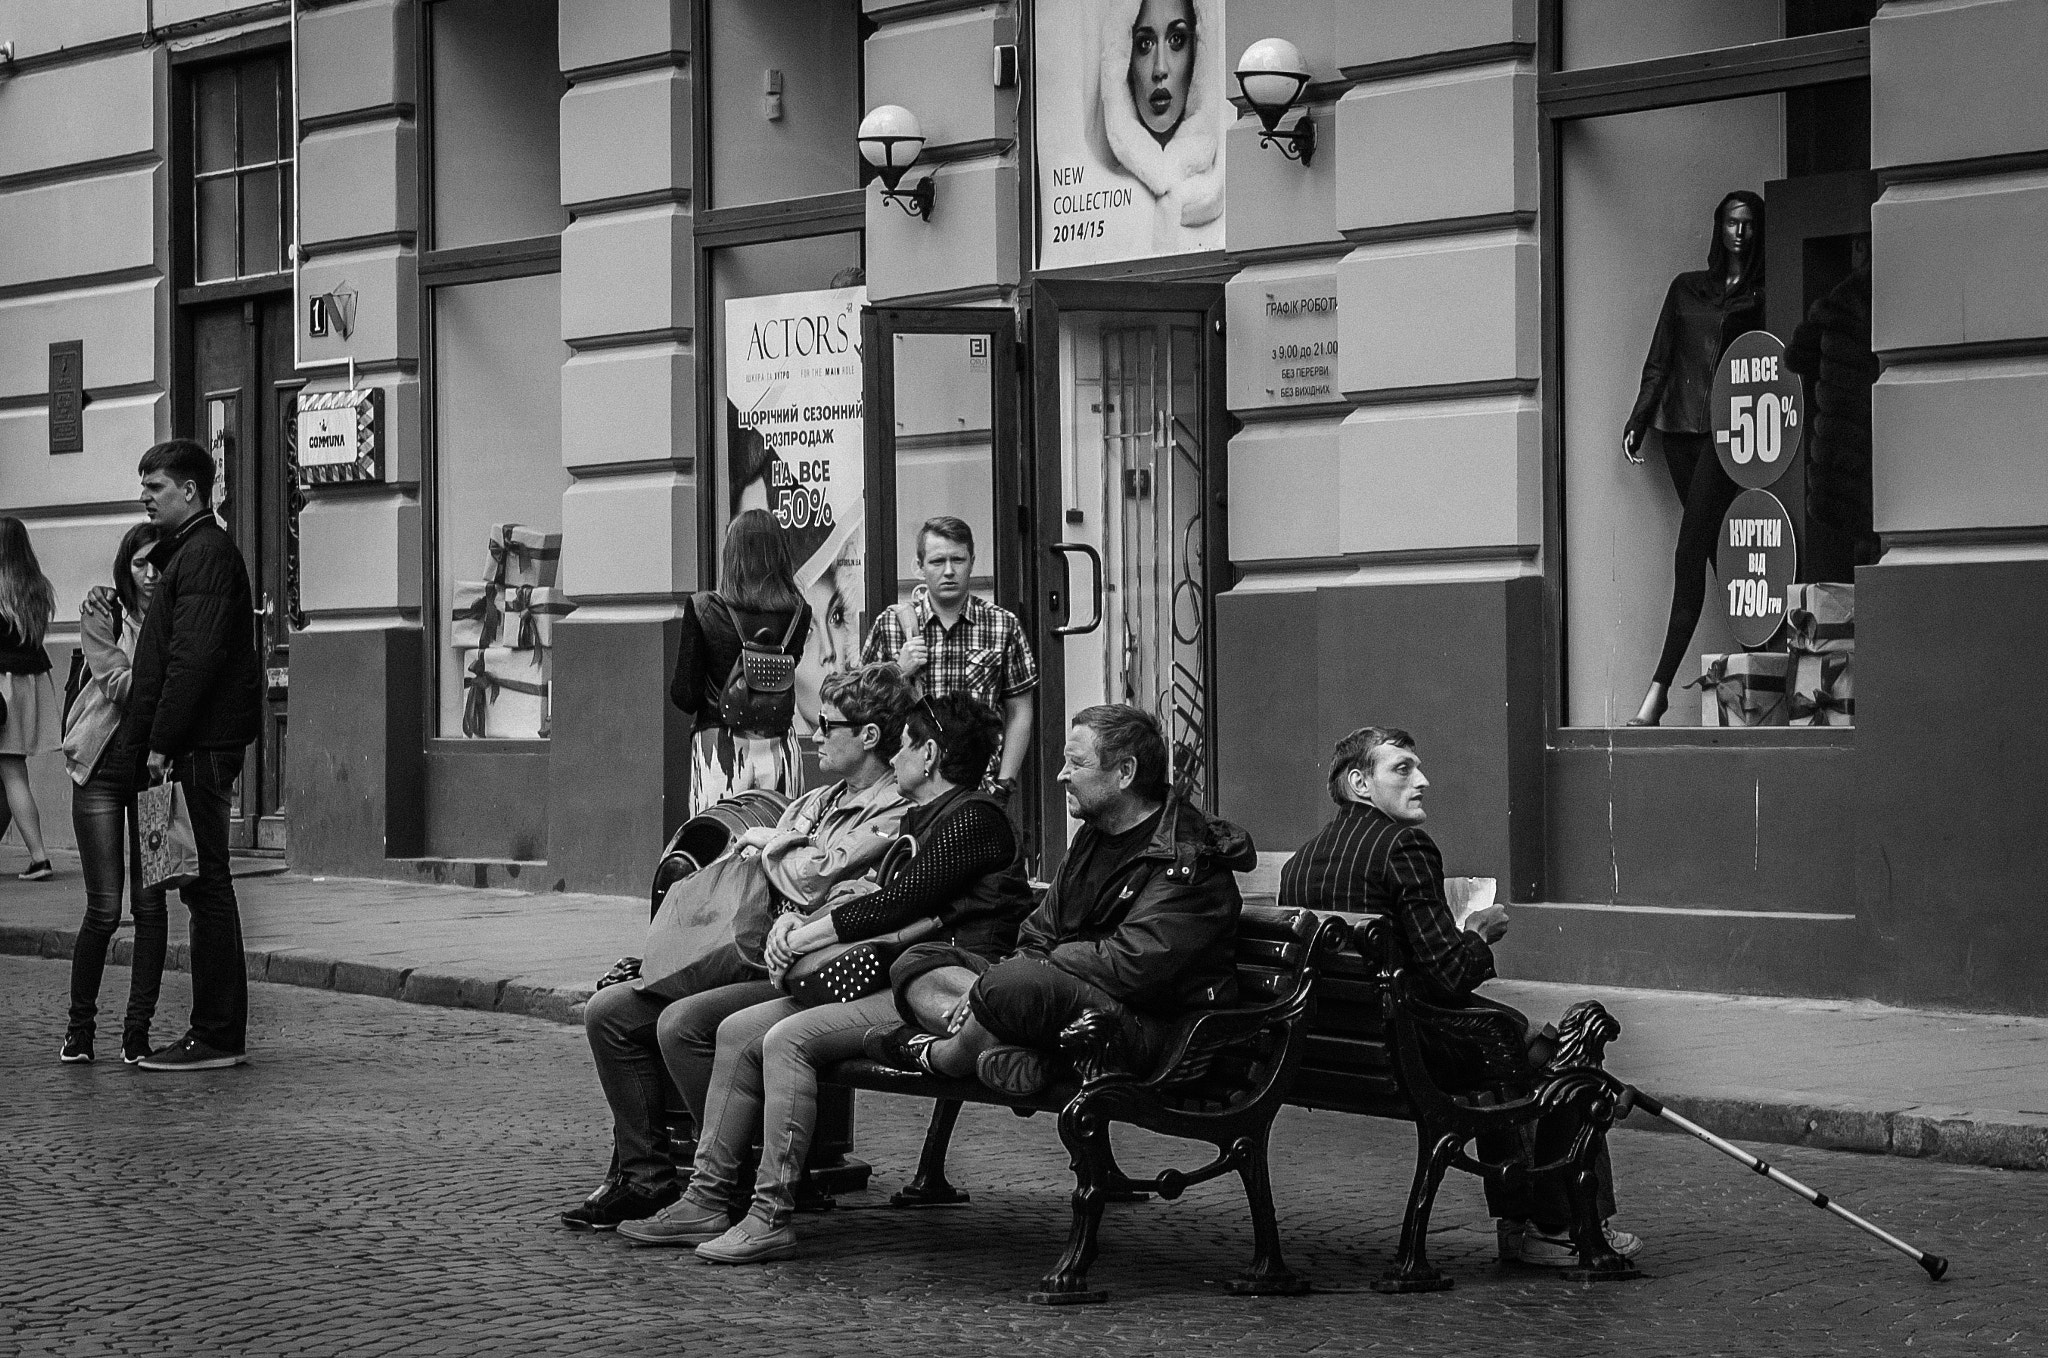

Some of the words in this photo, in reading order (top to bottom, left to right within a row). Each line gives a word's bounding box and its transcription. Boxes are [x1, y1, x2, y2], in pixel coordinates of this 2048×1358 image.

[1053, 166, 1084, 187] NEW
[1053, 188, 1132, 215] COLLECTION
[1053, 220, 1105, 243] 2014/15
[313, 300, 321, 331] 1
[1266, 300, 1299, 316] ГРАФІК
[747, 313, 849, 361] ACTORS
[1279, 345, 1298, 359] 9.00
[1300, 346, 1311, 358] до
[1313, 340, 1338, 356] 21.00
[825, 367, 840, 376] MAIN
[1281, 368, 1295, 379] БЕЗ
[1296, 365, 1329, 378] ПЕРЕРВИ
[1731, 358, 1750, 384] НА
[1752, 355, 1779, 382] ВСЕ
[1280, 387, 1293, 398] БЕЗ
[1295, 384, 1330, 397] ВИХІДНИХ
[739, 403, 799, 429] ЩОРІЧНИЙ
[803, 399, 863, 422] СЕЗОННИЙ
[765, 428, 834, 448] РОЗПРОДАЖ
[1716, 392, 1798, 464] -50%
[309, 434, 345, 449] COMMUNA
[773, 461, 793, 486] НА
[799, 459, 831, 483] ВСЕ
[1729, 518, 1781, 548] КУРТКИ
[1749, 552, 1766, 576] ВІД
